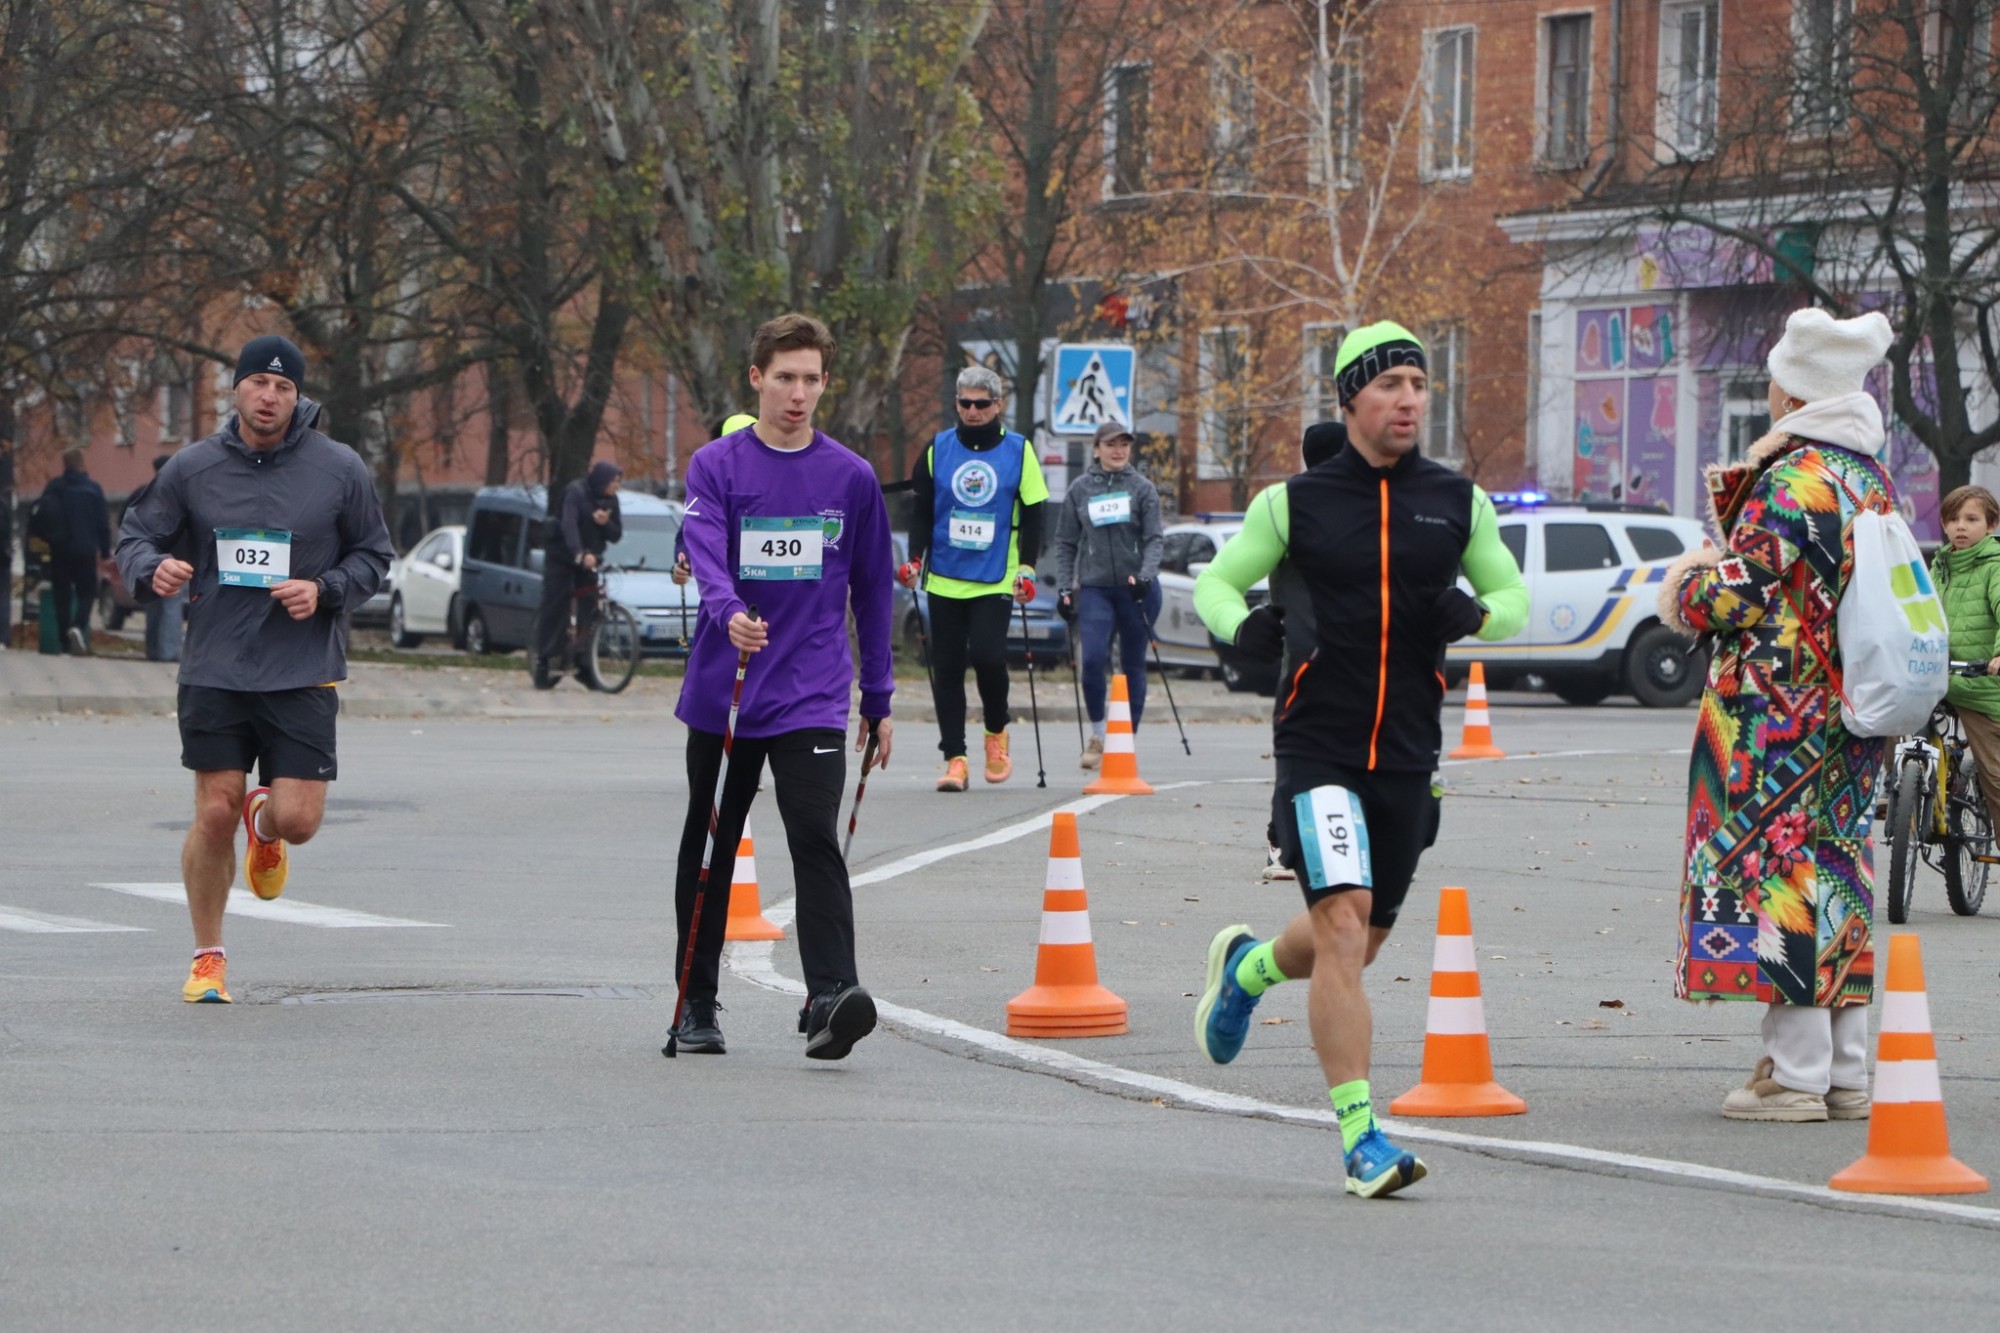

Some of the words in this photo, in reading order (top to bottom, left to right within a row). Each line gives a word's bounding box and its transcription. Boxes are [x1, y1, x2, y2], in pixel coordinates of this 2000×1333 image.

[1099, 503, 1119, 513] 429
[959, 525, 982, 536] 414
[235, 548, 270, 566] 032
[760, 539, 802, 557] 430
[1326, 813, 1350, 857] 461
